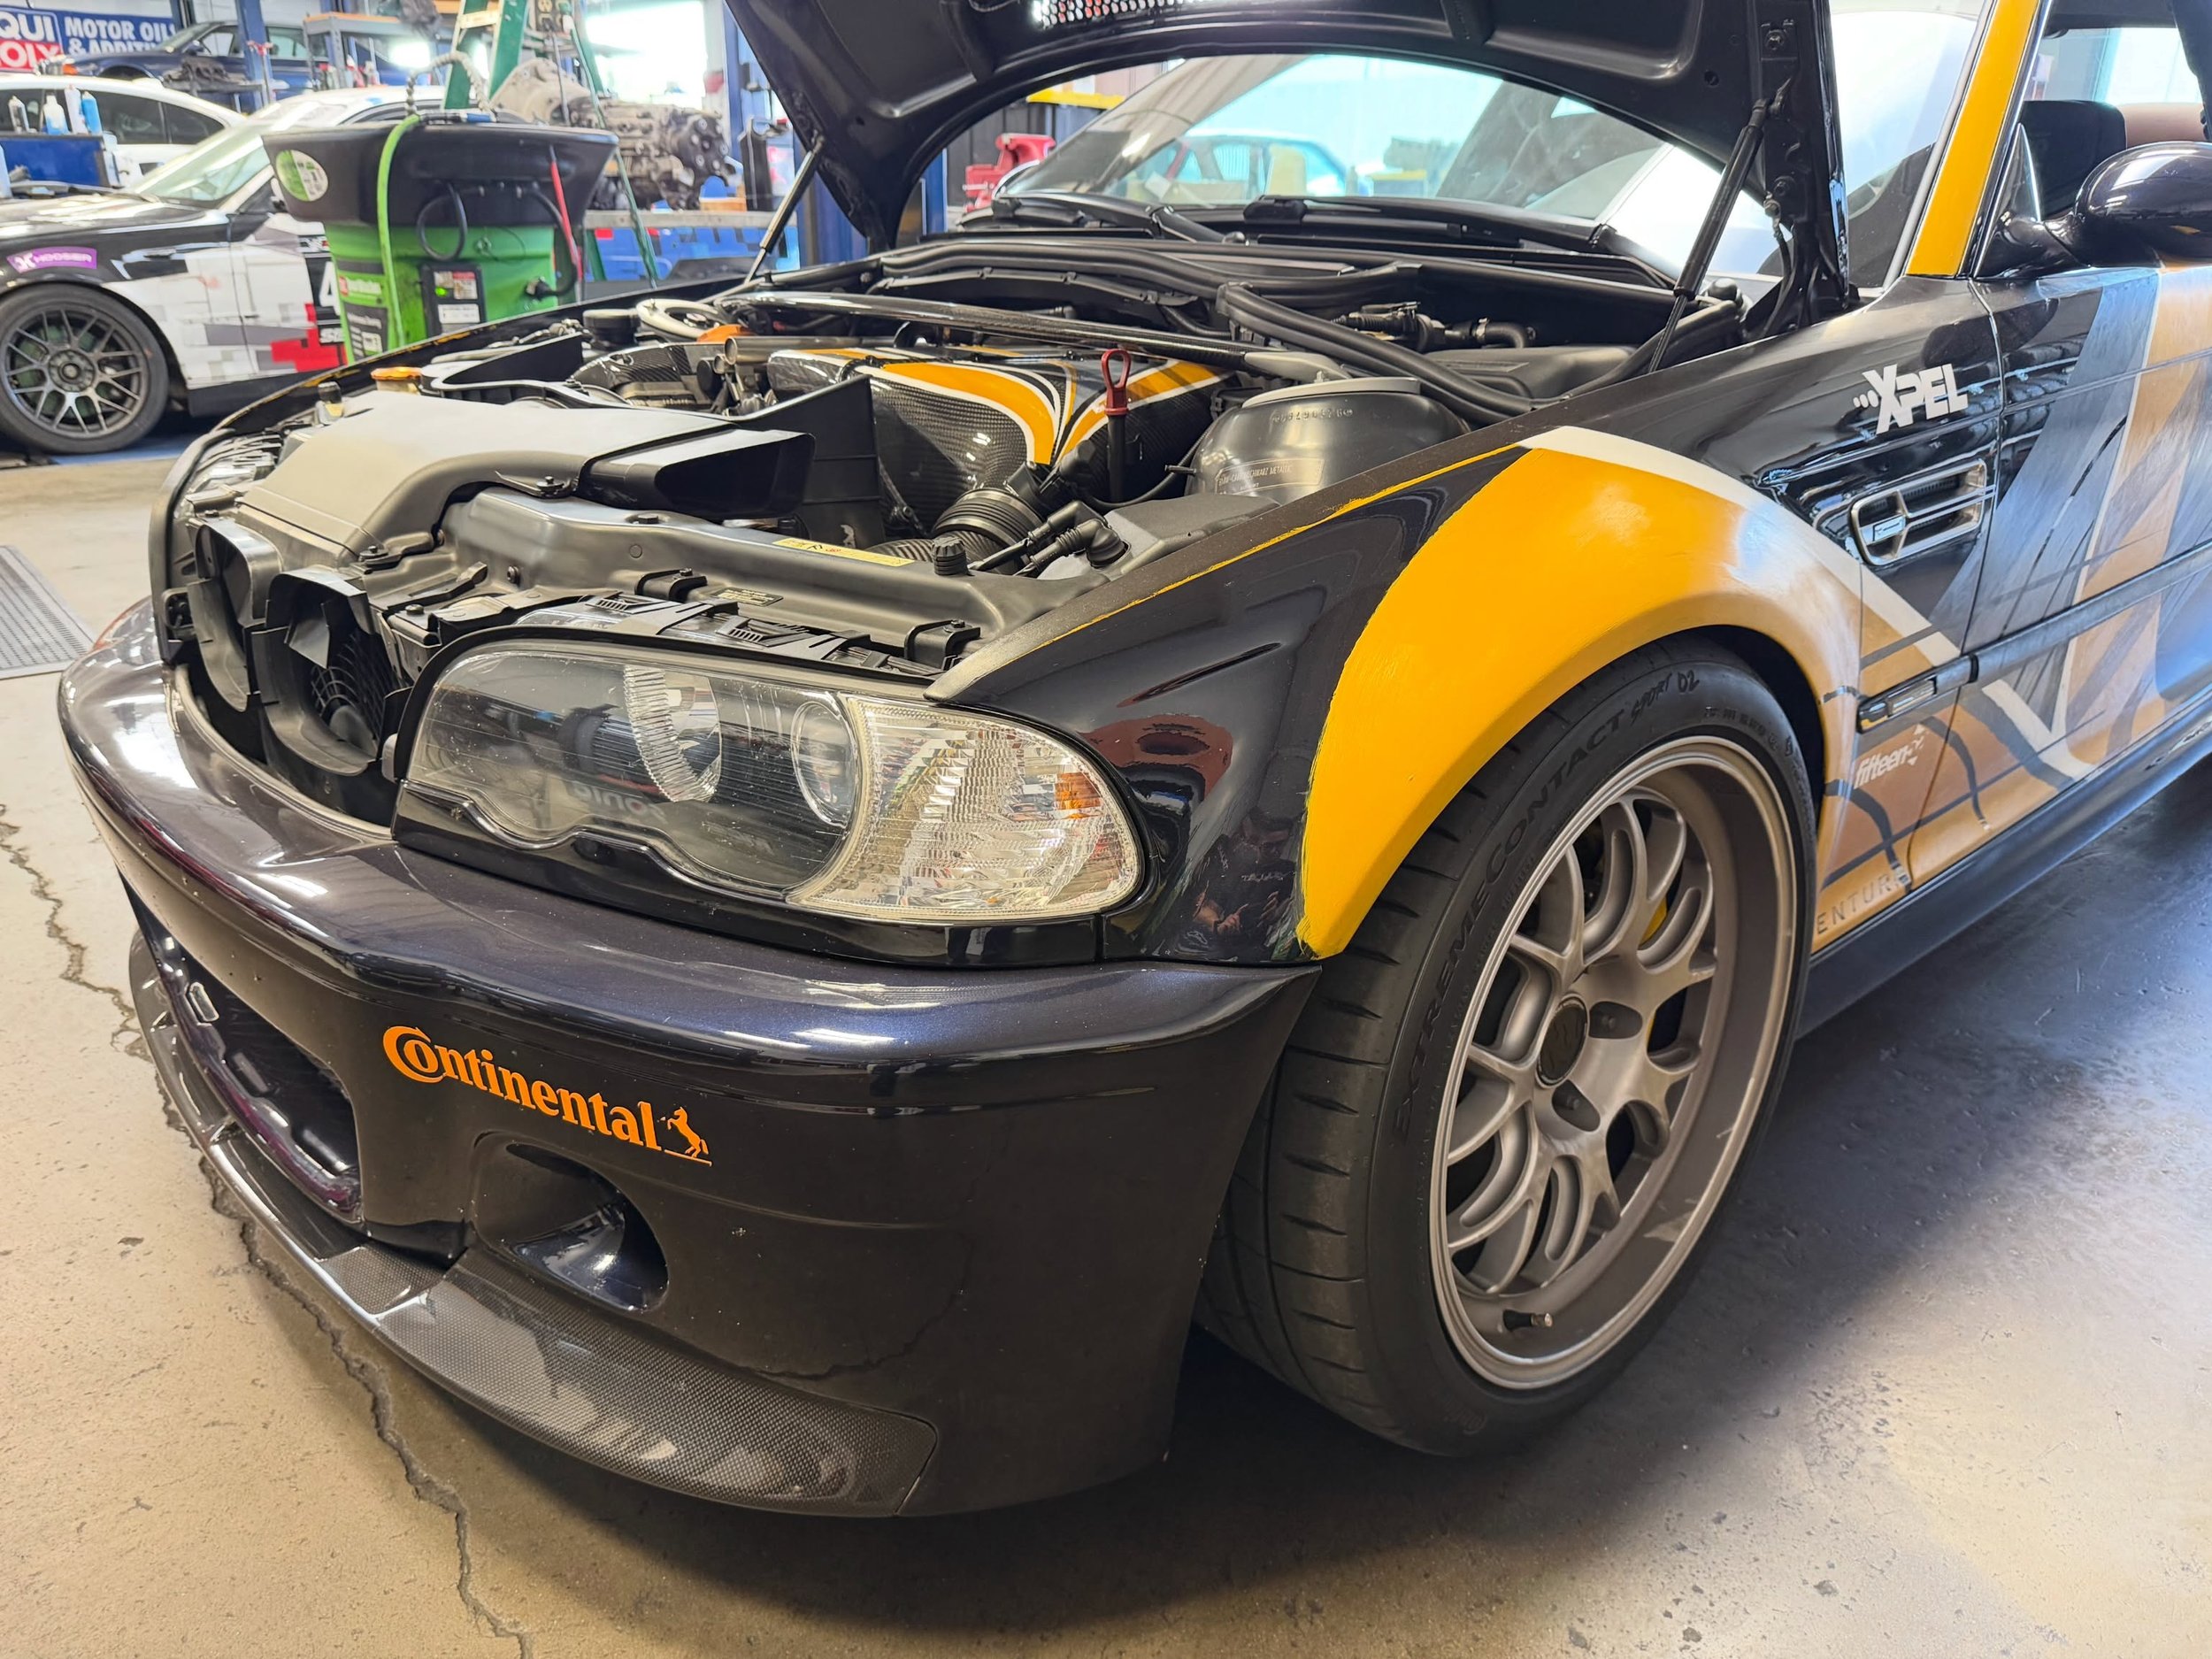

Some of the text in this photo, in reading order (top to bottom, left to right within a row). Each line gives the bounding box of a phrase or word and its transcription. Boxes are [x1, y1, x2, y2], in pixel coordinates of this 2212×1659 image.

[65, 16, 135, 41] MOTOR
[0, 41, 59, 70] OLY
[1862, 364, 1969, 434] XPEL
[382, 1025, 662, 1151] Continental
